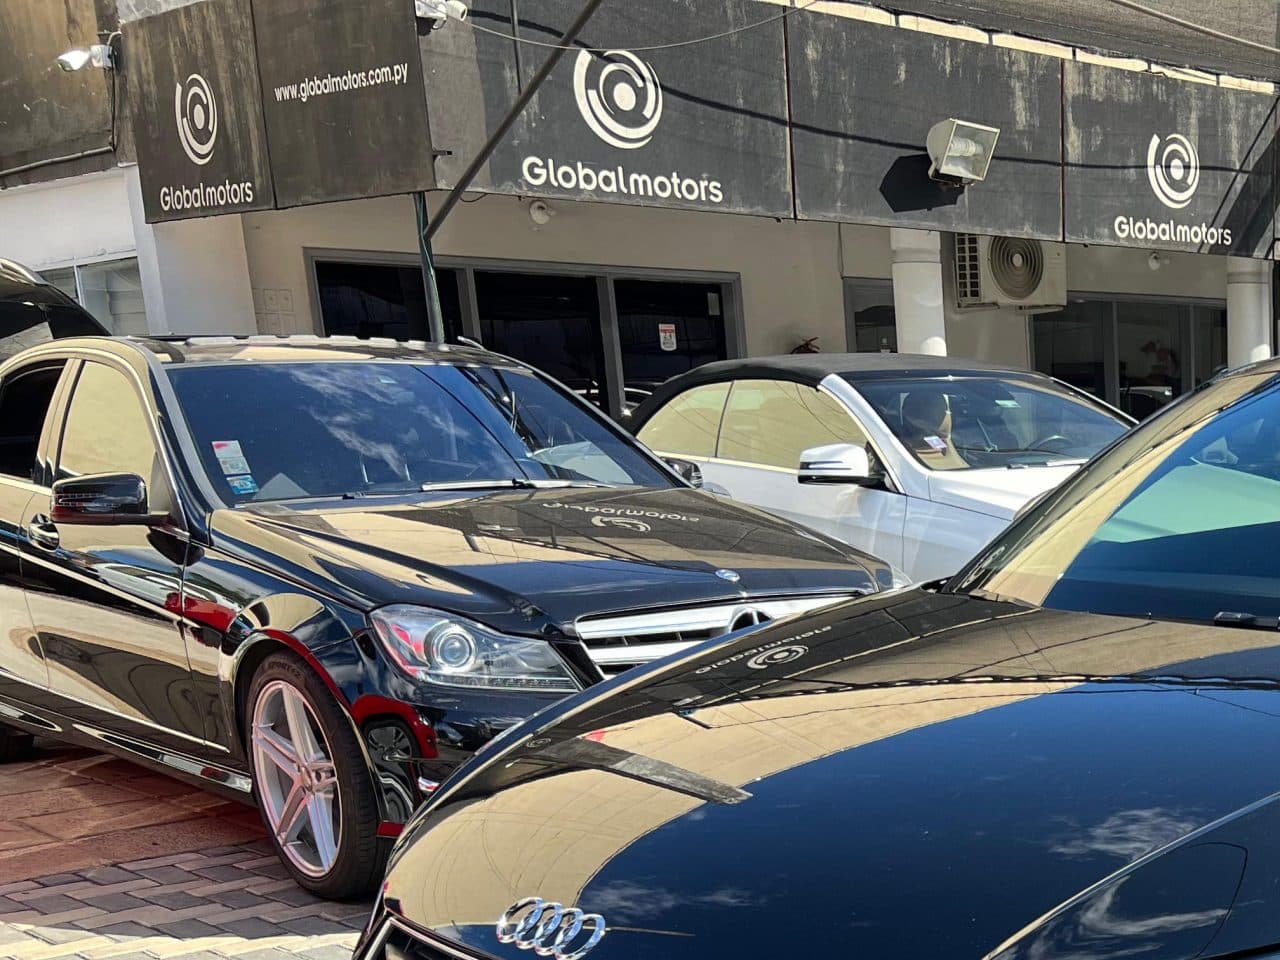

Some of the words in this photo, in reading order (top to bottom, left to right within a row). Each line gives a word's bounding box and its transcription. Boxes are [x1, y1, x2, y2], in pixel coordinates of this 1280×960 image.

[274, 63, 408, 102] www.globalmotors.com.py
[160, 179, 253, 211] Globalmotors
[522, 156, 723, 203] Globalmotors
[1114, 215, 1232, 246] Globalmotors
